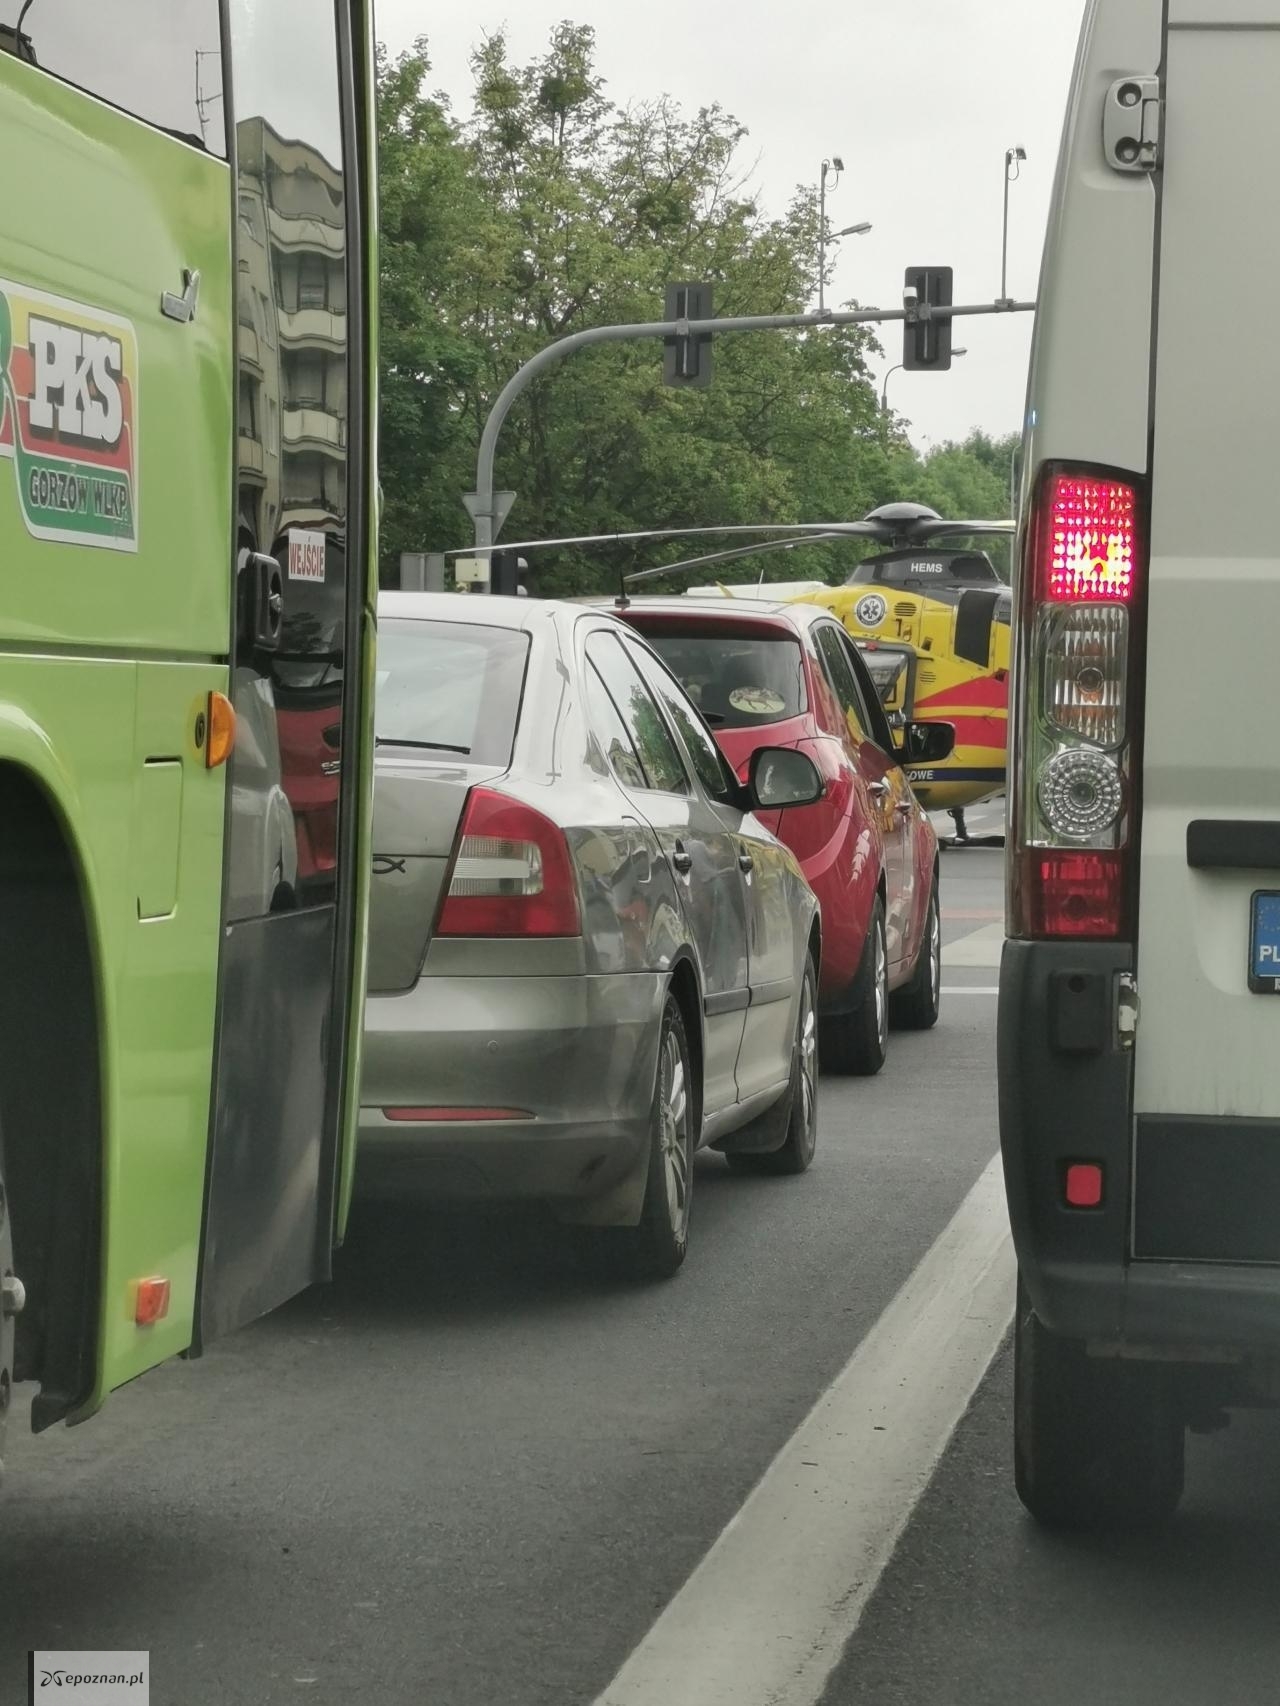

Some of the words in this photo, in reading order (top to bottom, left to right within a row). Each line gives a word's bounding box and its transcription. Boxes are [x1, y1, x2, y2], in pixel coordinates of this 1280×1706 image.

[29, 315, 123, 445] PKS
[290, 536, 324, 577] WEJŚCIE
[911, 563, 943, 573] HEMS
[1260, 945, 1280, 962] PL
